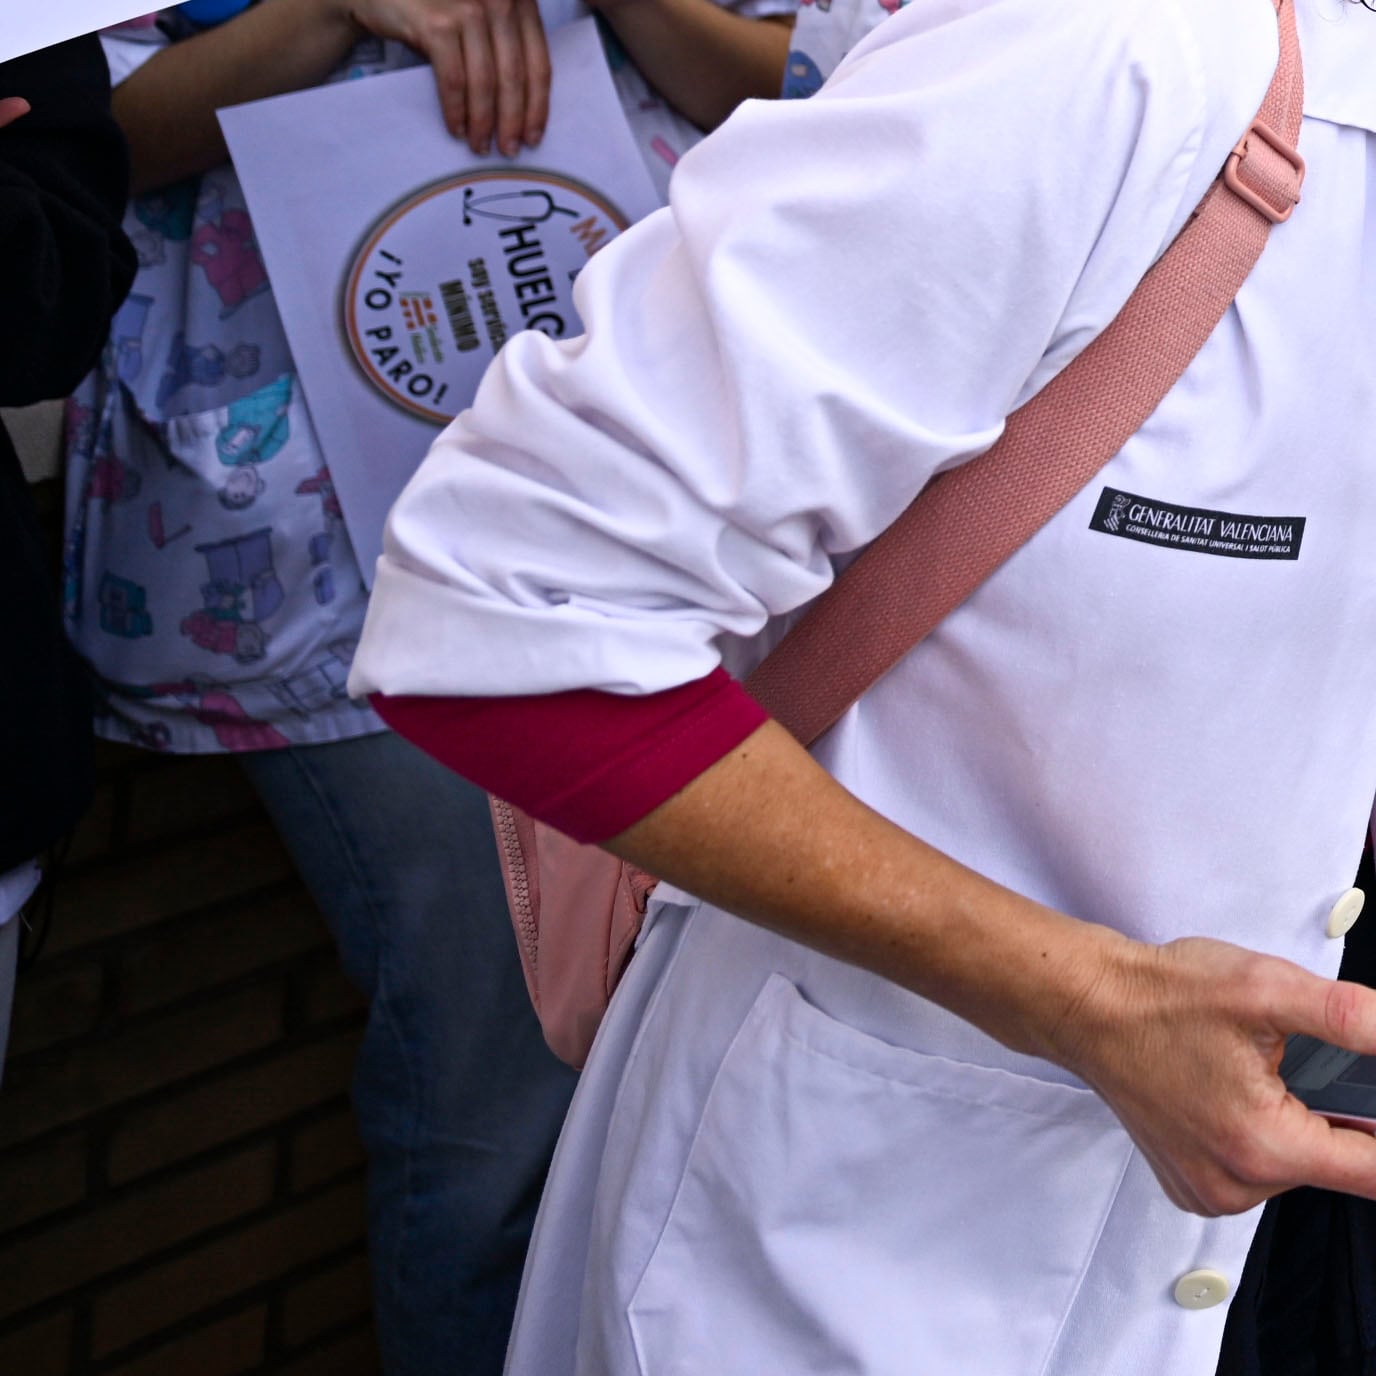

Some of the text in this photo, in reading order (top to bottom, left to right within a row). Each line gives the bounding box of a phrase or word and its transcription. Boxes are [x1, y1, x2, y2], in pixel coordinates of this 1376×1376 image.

[498, 224, 566, 335] HUELG
[365, 325, 449, 406] PARO!
[1125, 523, 1169, 541] CONSELLERIA
[1170, 535, 1180, 543] DE
[1180, 535, 1209, 547] SANITAT
[1209, 540, 1244, 552] UNIVERSAL
[1268, 542, 1291, 554] PÚBLICA
[1128, 503, 1293, 542] GENERALITAT VALENCIANA
